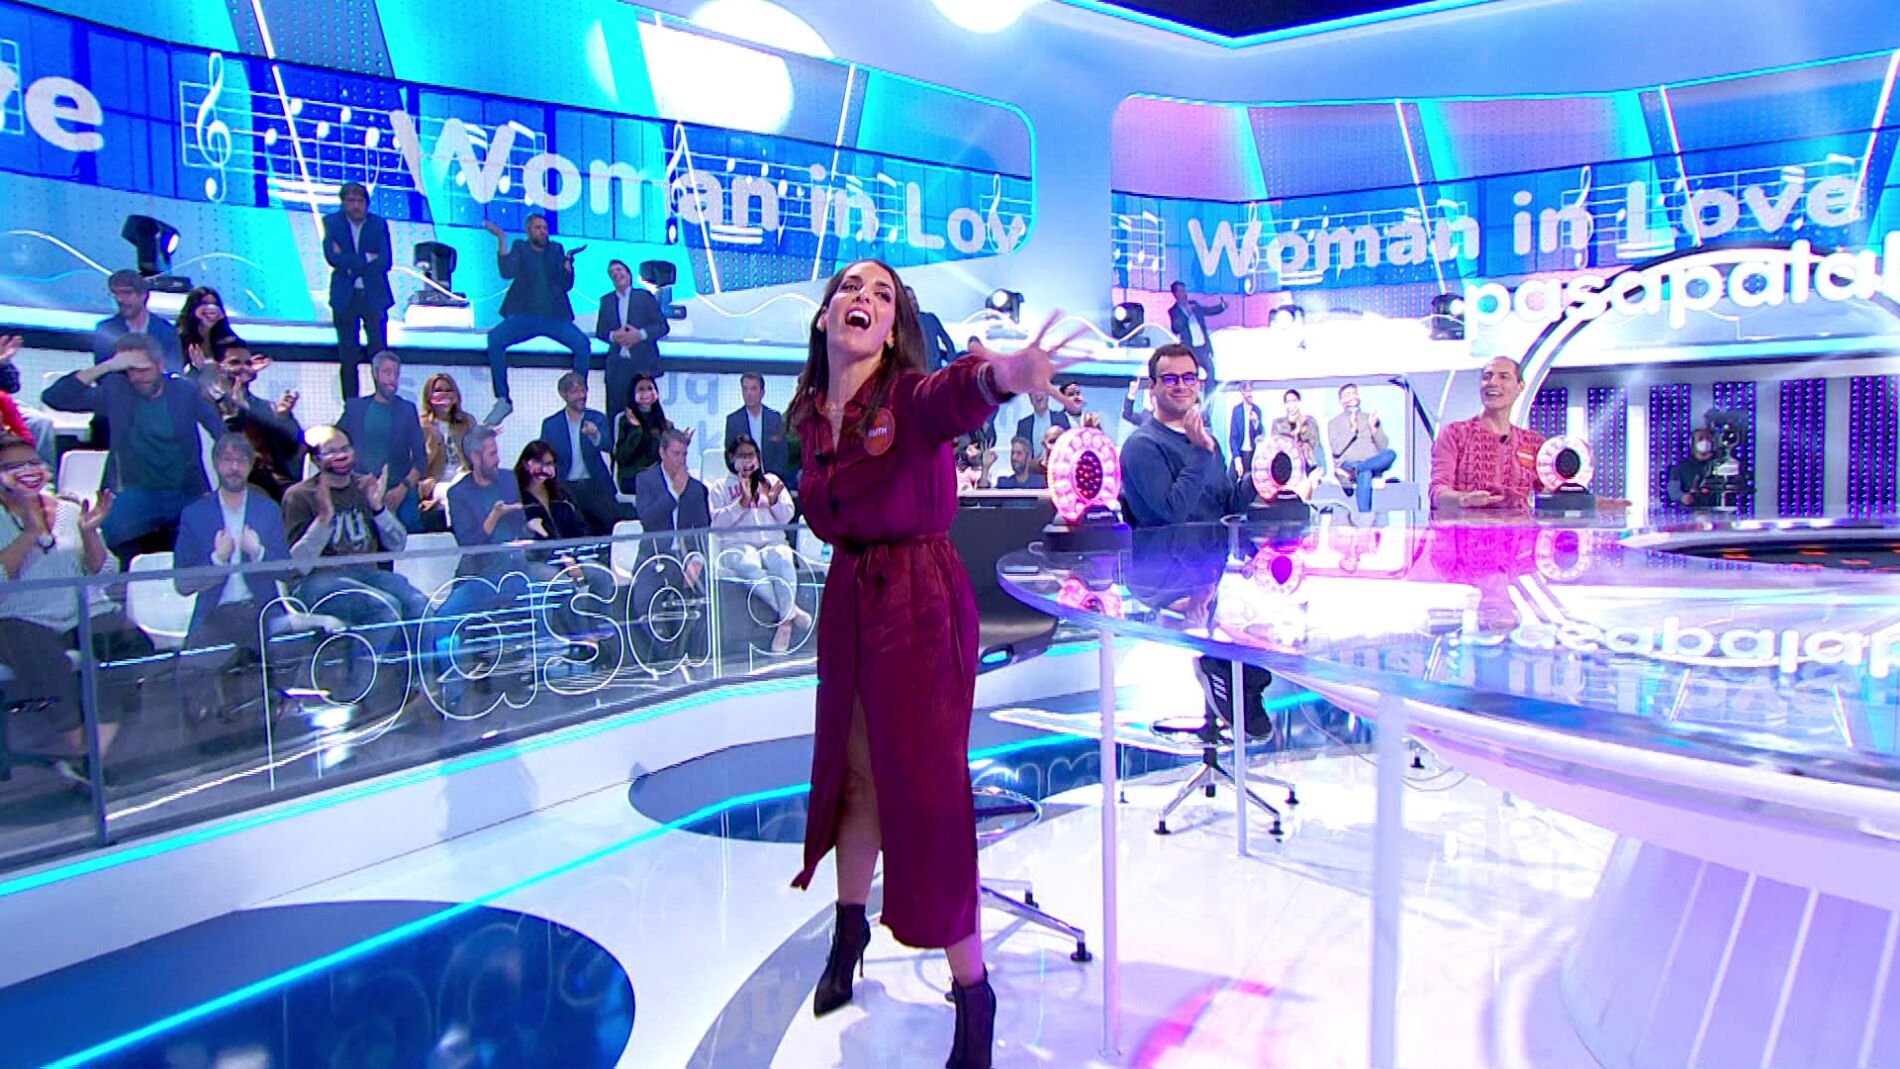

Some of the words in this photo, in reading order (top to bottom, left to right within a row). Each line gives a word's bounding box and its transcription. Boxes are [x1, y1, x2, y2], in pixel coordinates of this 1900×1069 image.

[0, 61, 104, 151] e
[390, 110, 779, 231] Woman
[810, 164, 878, 242] in
[1188, 216, 1480, 277] Woman
[1513, 190, 1590, 255] in
[1626, 176, 1865, 248] Love
